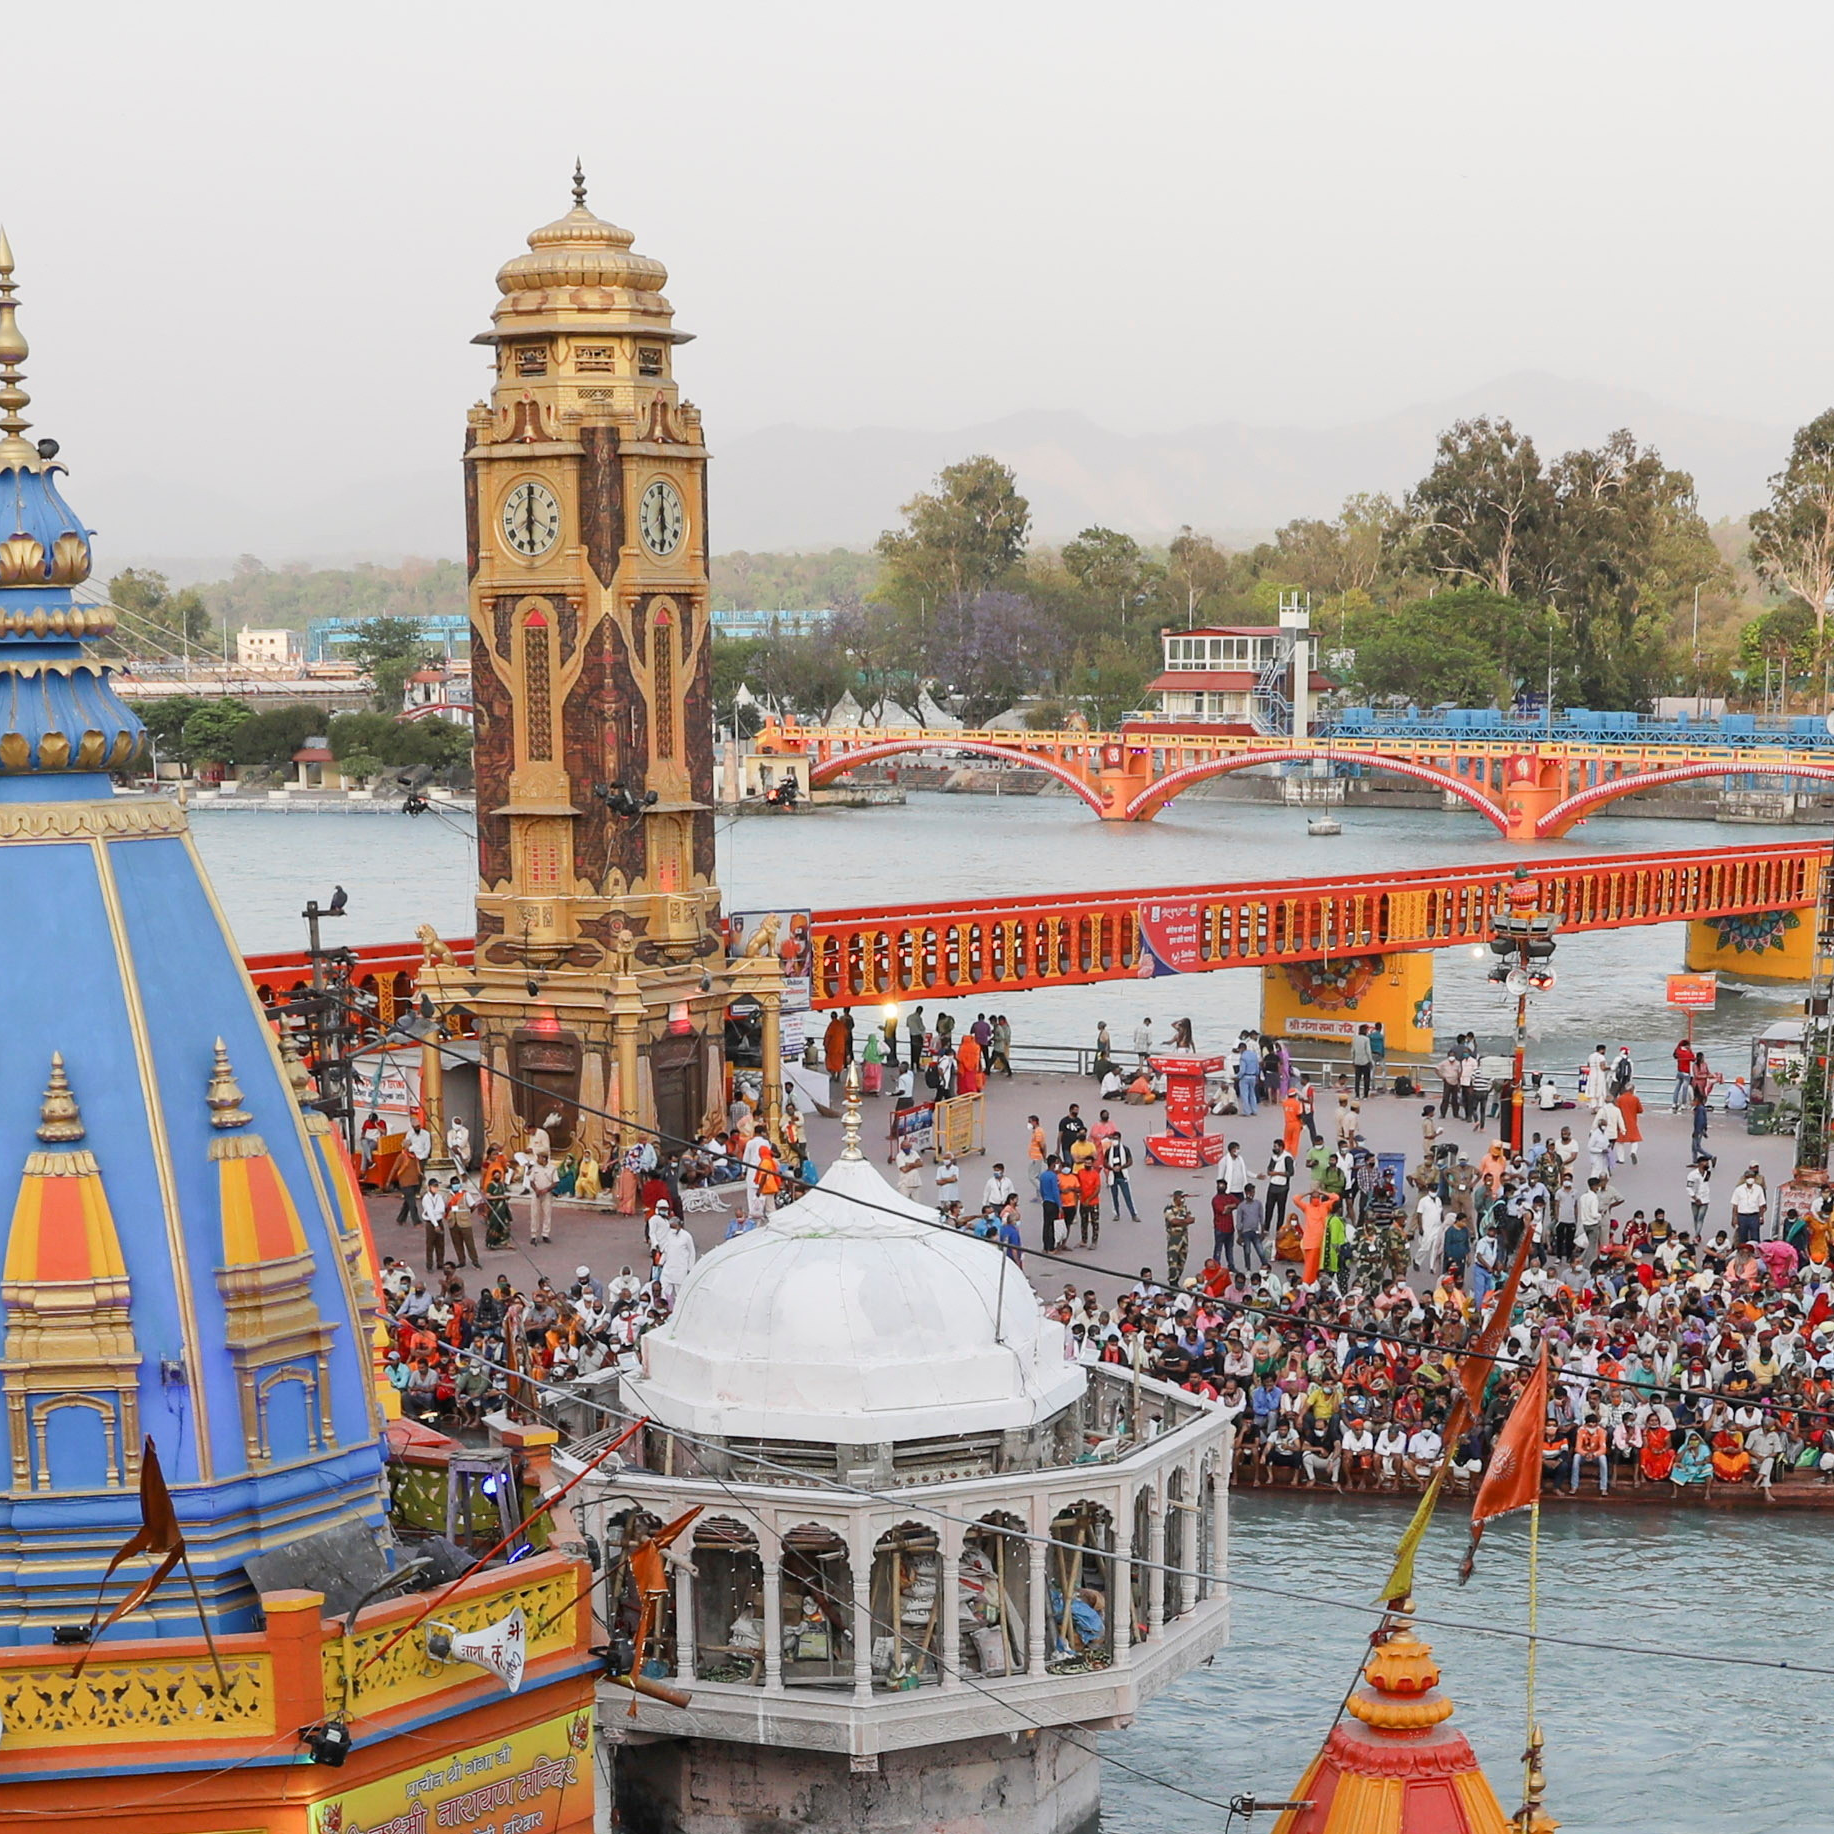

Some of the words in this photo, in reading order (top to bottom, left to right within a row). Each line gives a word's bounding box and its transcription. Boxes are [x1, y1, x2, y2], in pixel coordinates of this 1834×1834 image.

[1301, 1022, 1317, 1031] गंगा
[406, 1771, 444, 1800] प्राचीन
[446, 1761, 463, 1785] श्री
[465, 1754, 493, 1775] गंगा
[495, 1743, 512, 1766] जी
[437, 1776, 515, 1828] नारायण
[517, 1755, 578, 1802] मन्दिर
